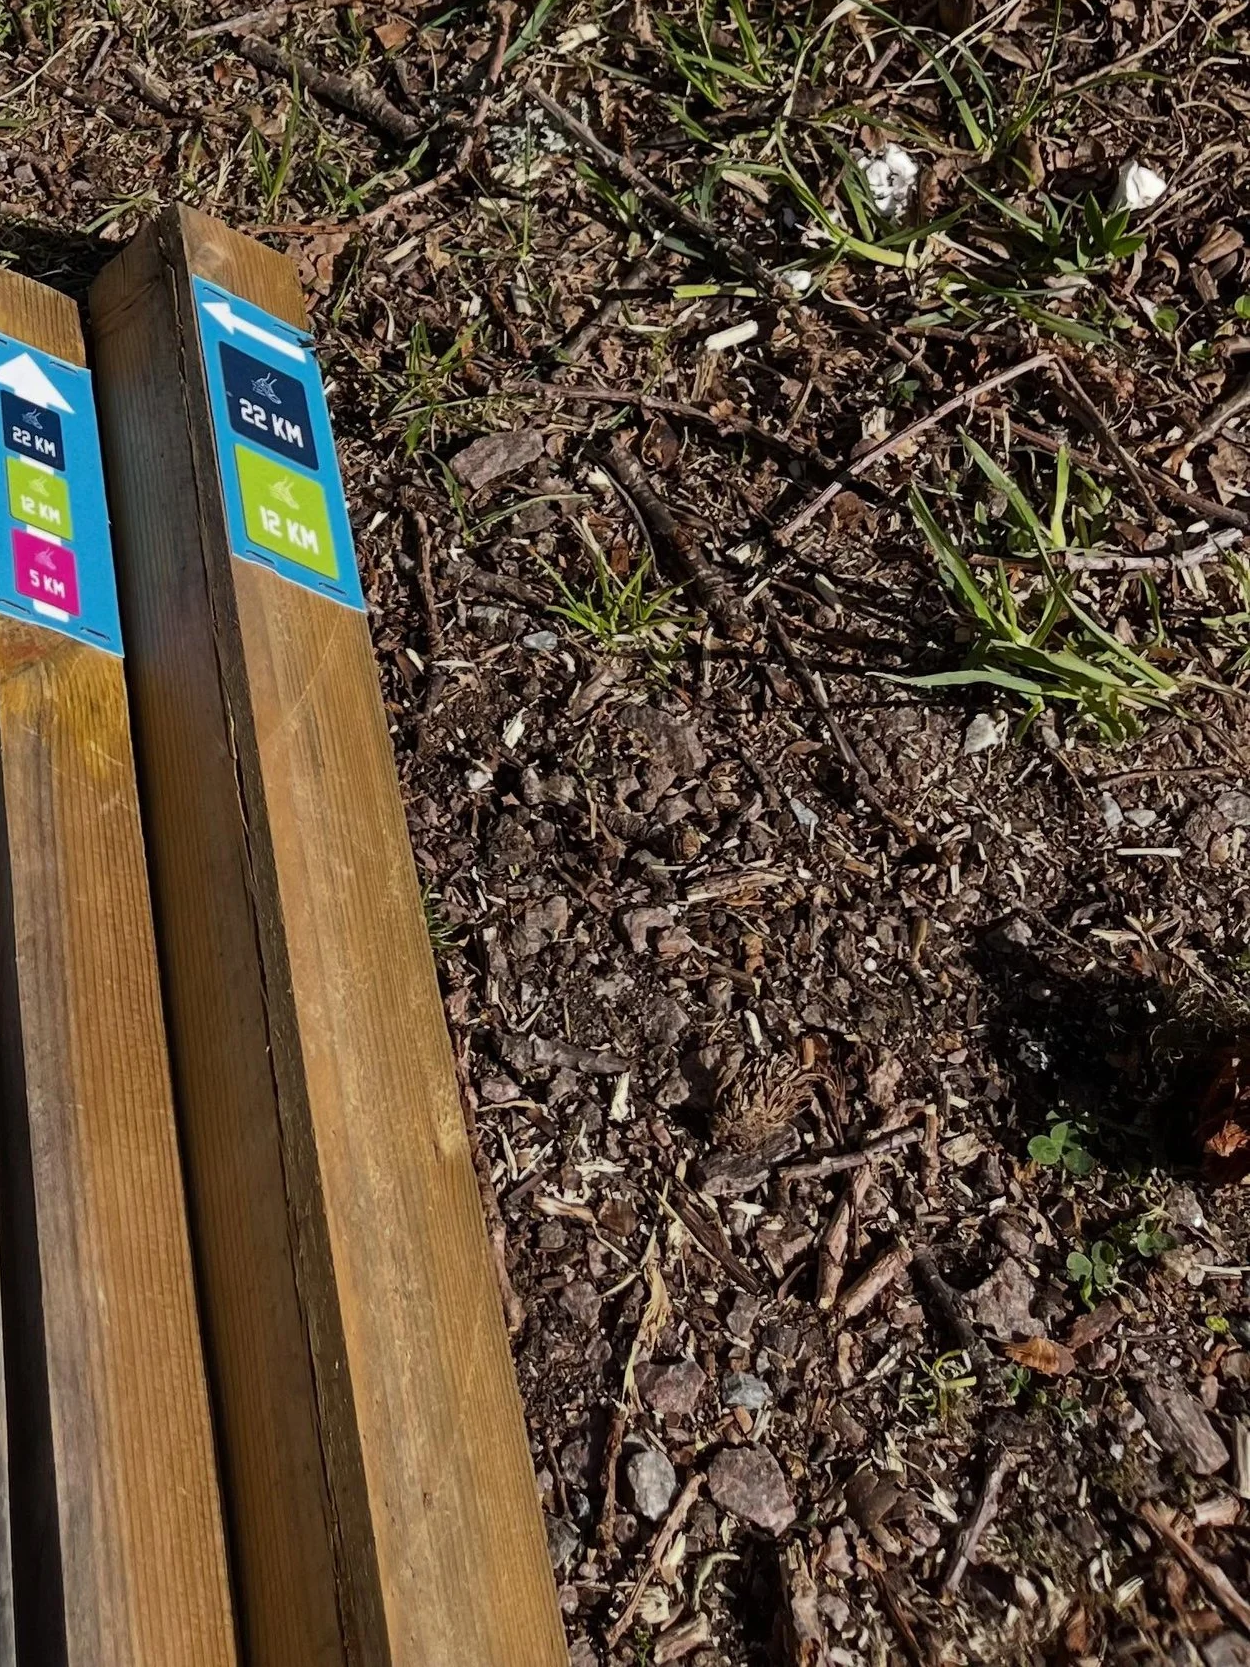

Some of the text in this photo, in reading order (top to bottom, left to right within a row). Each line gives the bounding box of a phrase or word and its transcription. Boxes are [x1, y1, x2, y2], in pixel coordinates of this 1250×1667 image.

[239, 397, 304, 448] 22 KM
[12, 426, 56, 457] 22 KM
[20, 495, 61, 525] 12 KM
[259, 506, 320, 555] 12 KM
[29, 569, 66, 599] 5 KM
